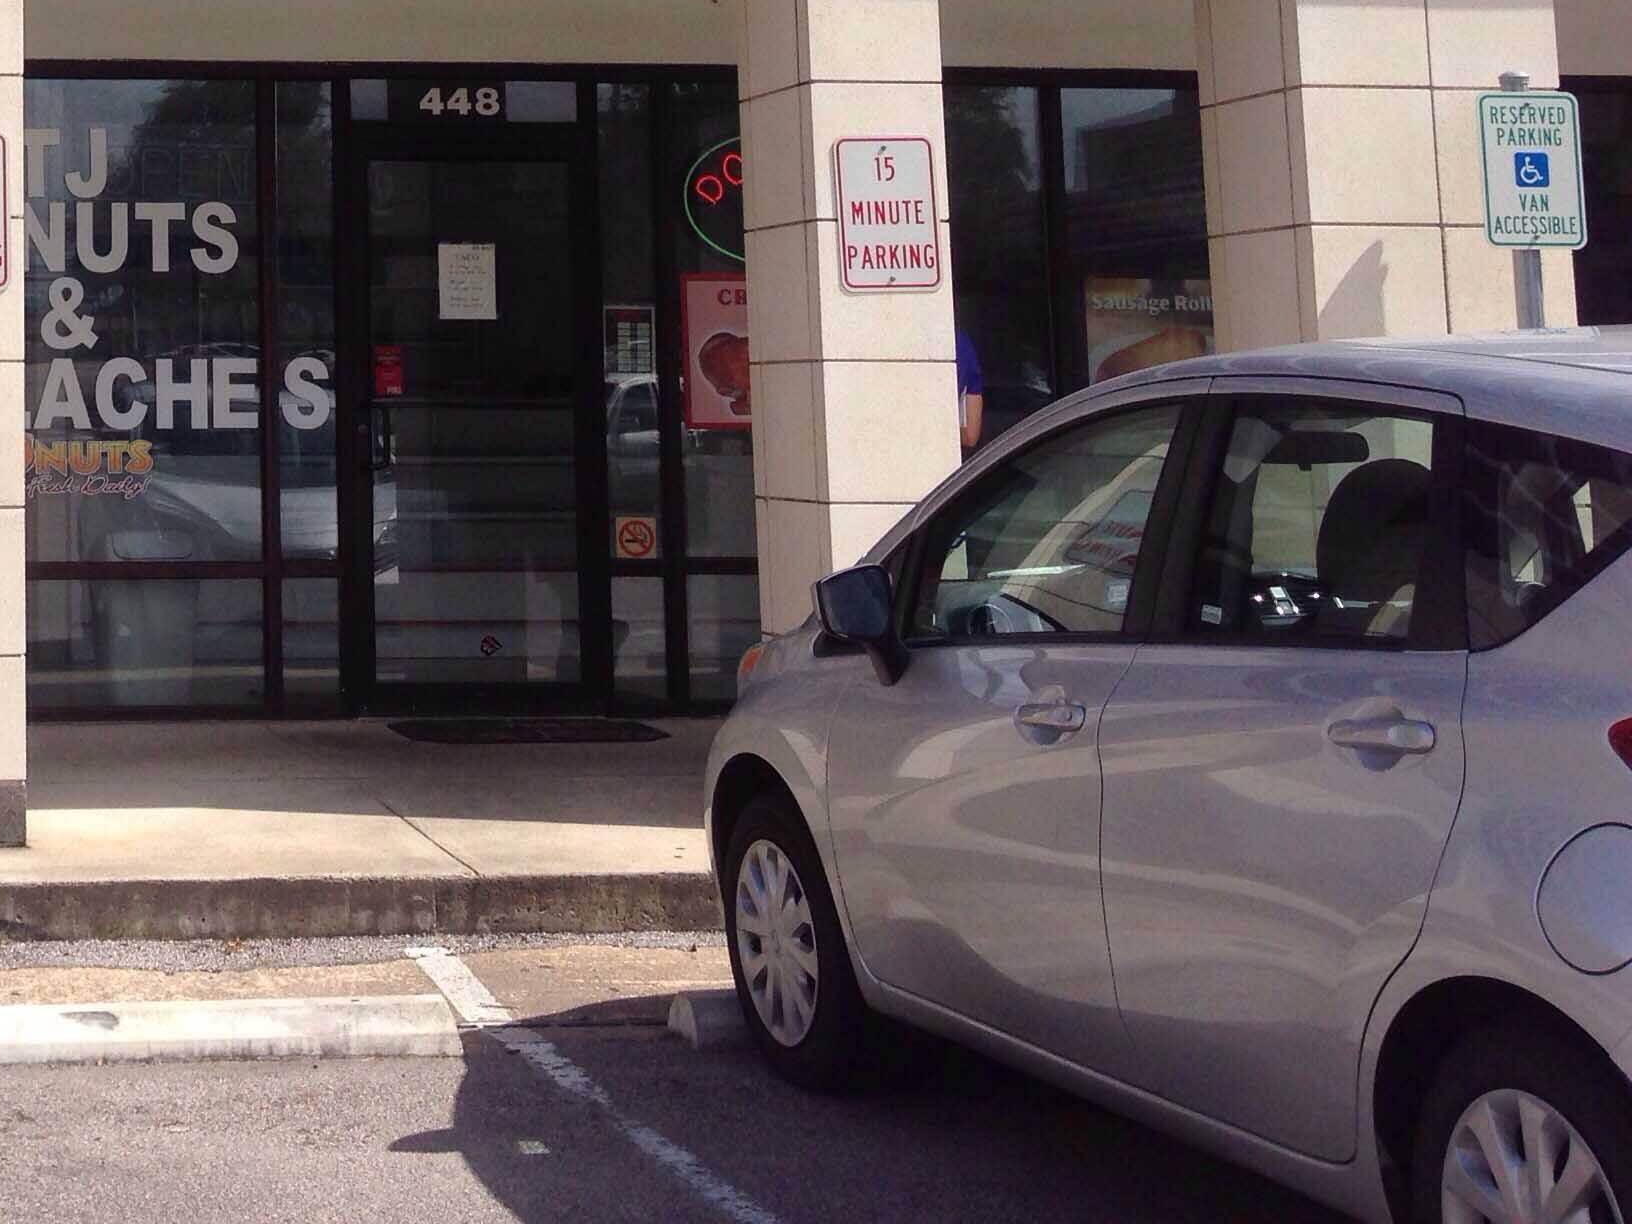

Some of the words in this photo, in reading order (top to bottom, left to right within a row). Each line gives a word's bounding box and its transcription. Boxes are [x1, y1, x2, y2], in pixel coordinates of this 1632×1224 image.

[419, 87, 500, 116] 448
[1489, 105, 1566, 125] RESERVED
[1496, 127, 1562, 146] PARKING
[24, 128, 108, 198] TJ
[874, 156, 896, 181] 15
[850, 199, 926, 225] MINUTE
[1518, 193, 1550, 212] VAN
[24, 202, 239, 273] NUTS
[1494, 215, 1578, 235] ACCESSIBLE
[847, 243, 935, 270] PARKING
[40, 276, 99, 350] &
[1091, 294, 1170, 316] Sausage
[1174, 295, 1211, 312] Roll
[25, 357, 331, 430] ACHES
